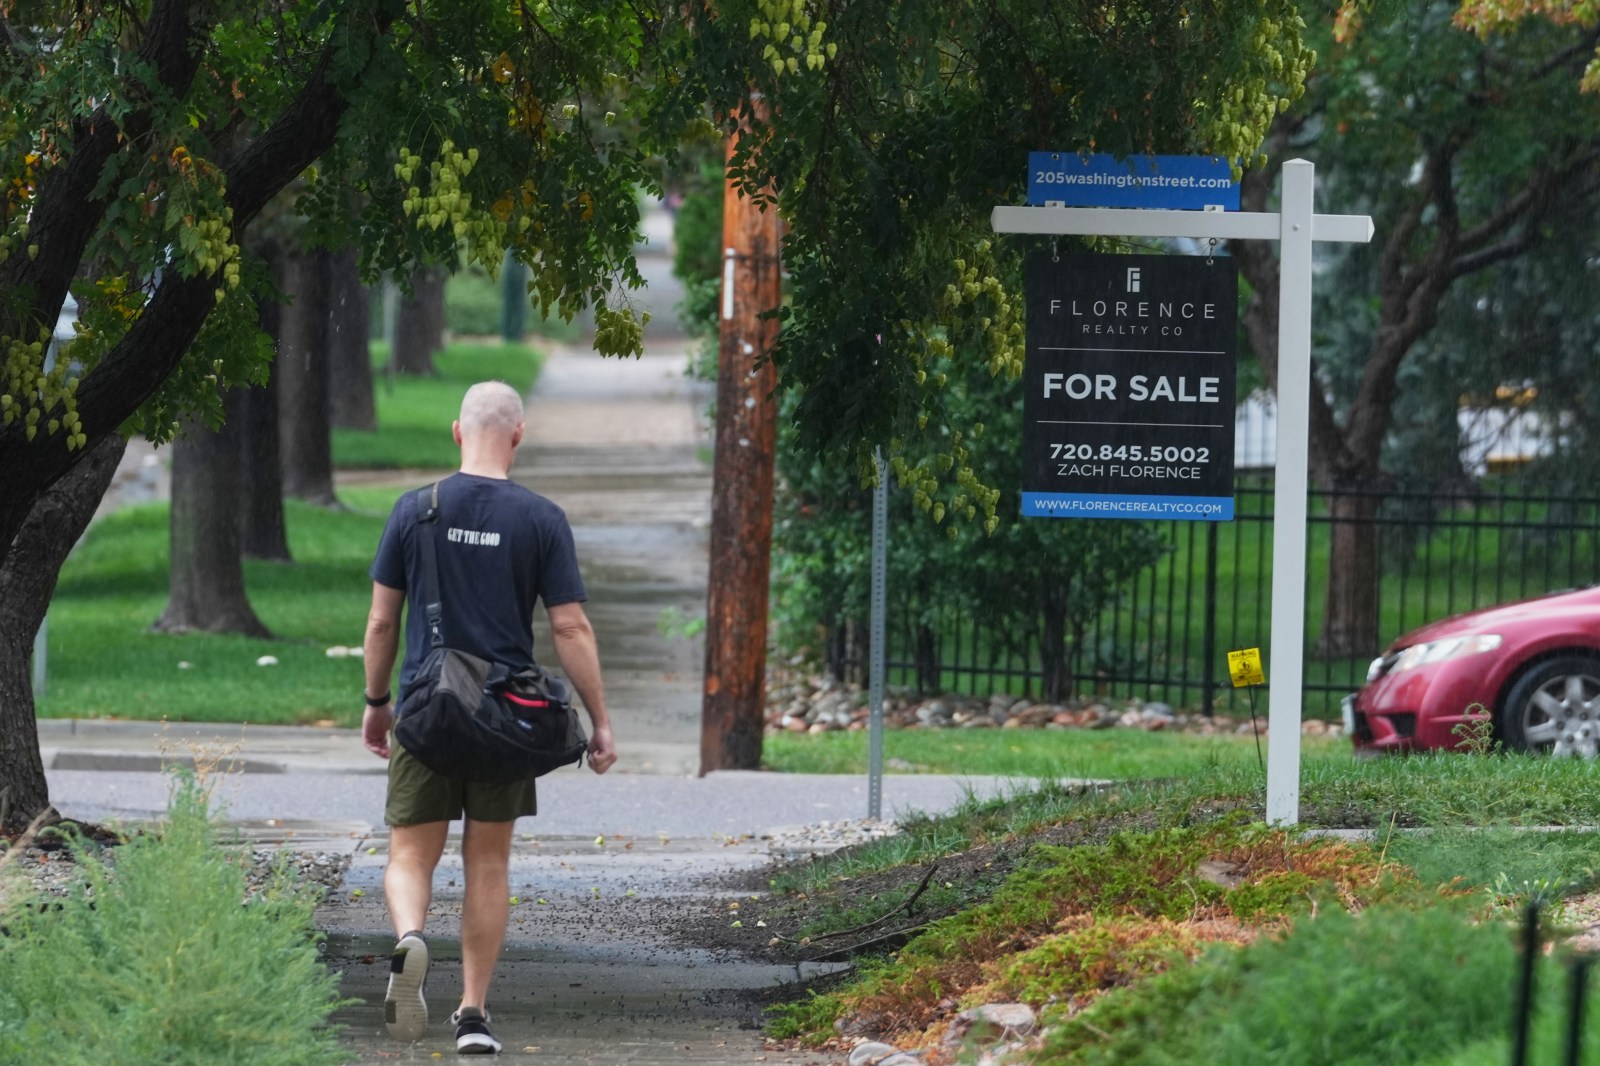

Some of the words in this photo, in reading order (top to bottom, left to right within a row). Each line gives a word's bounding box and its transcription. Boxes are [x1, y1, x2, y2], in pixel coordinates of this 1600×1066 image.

[1050, 300, 1215, 319] FLORENCE
[1082, 324, 1149, 335] REALTY
[1161, 326, 1183, 336] CO
[1043, 373, 1117, 400] FOR
[1128, 375, 1220, 403] SALE
[1050, 443, 1210, 463] 720.845.5002
[1057, 463, 1104, 477] ZACH
[1109, 465, 1201, 479] FLORENCE
[1035, 499, 1222, 514] WWW.FLORENCEREALTYCO.COM
[447, 527, 463, 542] GET
[464, 530, 480, 545] THE
[480, 532, 500, 546] GOOD
